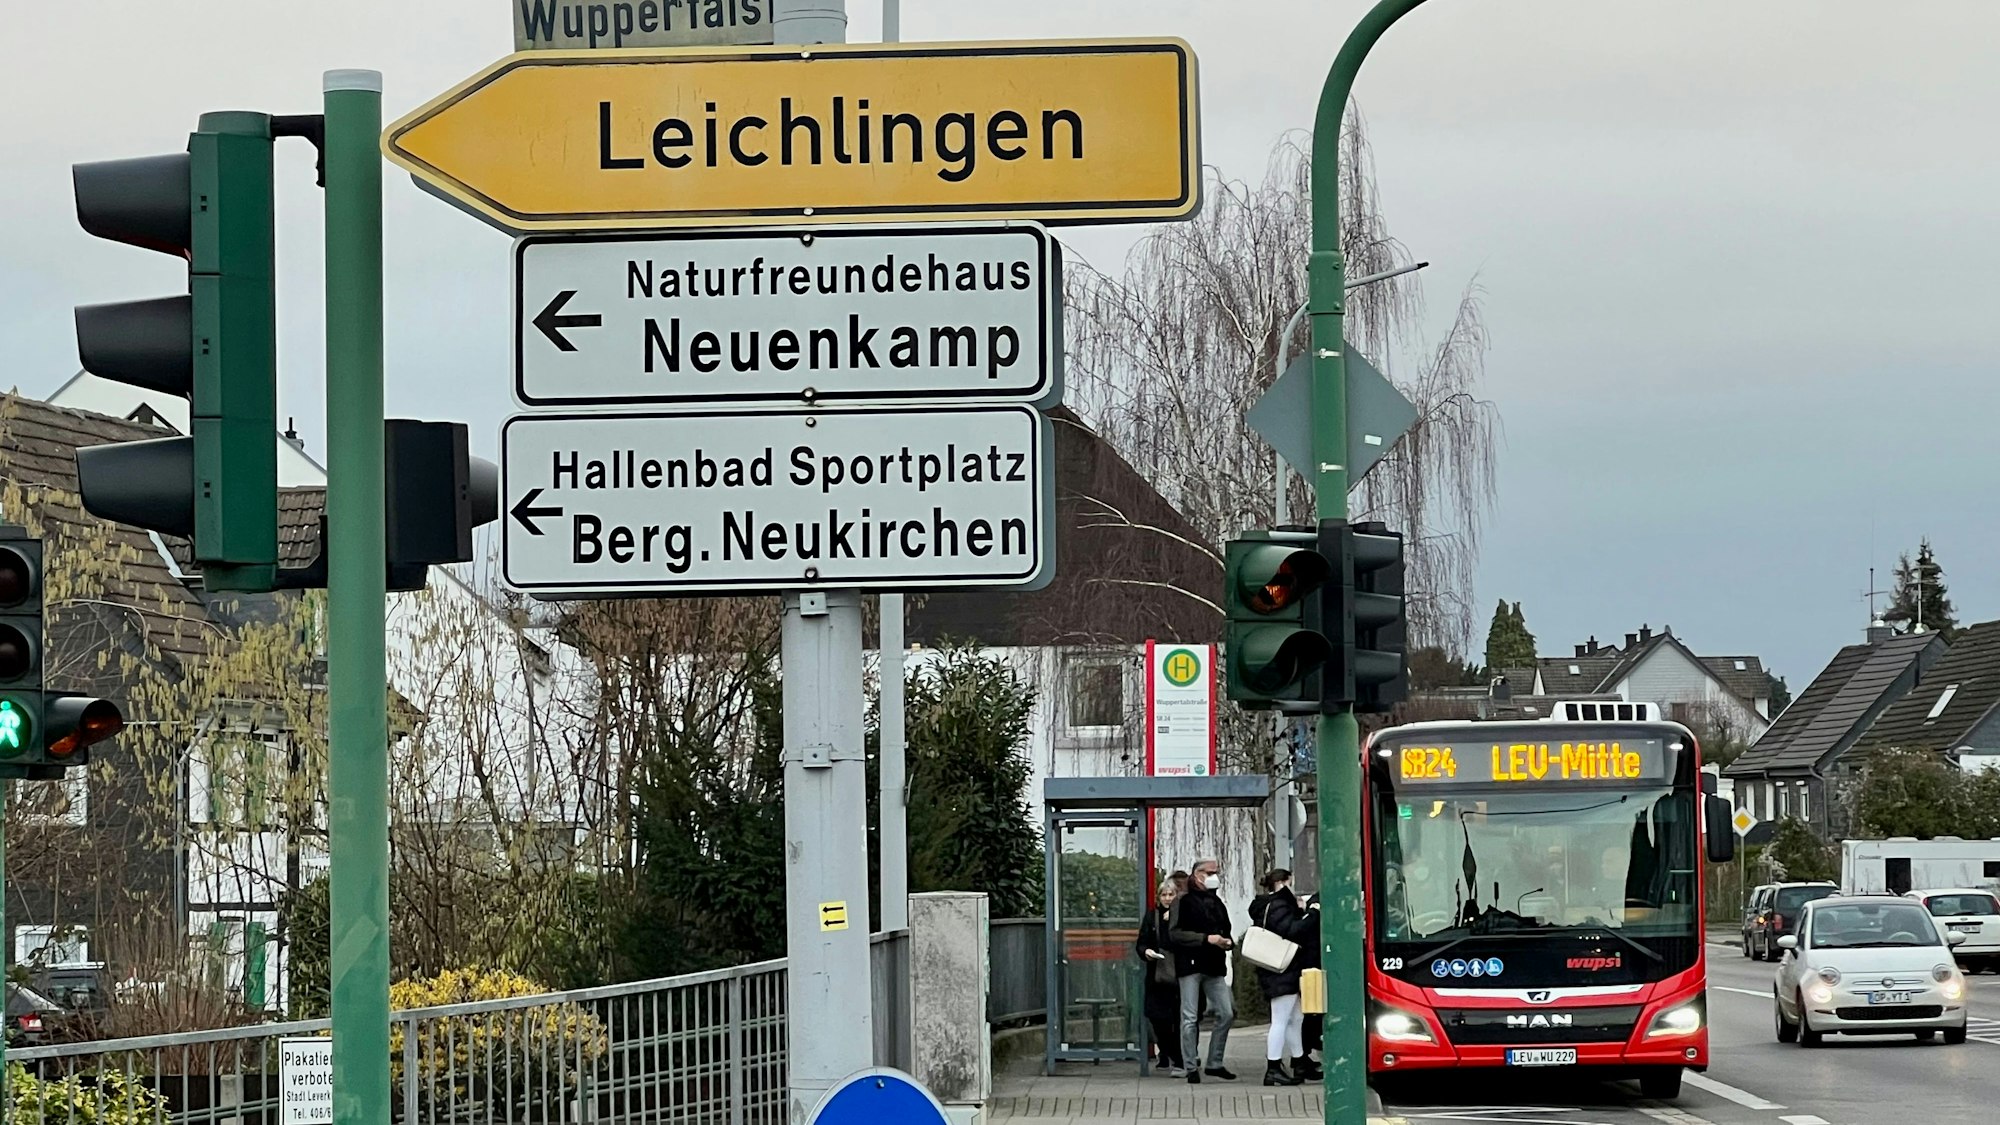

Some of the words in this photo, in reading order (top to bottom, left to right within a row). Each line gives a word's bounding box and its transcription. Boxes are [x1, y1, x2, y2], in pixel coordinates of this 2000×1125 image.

[600, 96, 1083, 182] Leichlingen
[627, 253, 1031, 298] Naturfreundehaus
[644, 314, 1020, 379] Neuenkamp
[553, 447, 773, 490] Hallenbad
[789, 444, 1026, 493] Sportplatz
[1174, 656, 1189, 678] H
[1158, 764, 1191, 775] wupsi
[1491, 743, 1641, 781] LEV-Mitte
[1382, 957, 1403, 970] 229
[1567, 952, 1621, 971] wupsi
[1507, 1014, 1573, 1028] MAN
[1513, 1051, 1533, 1063] LEV
[1540, 1051, 1553, 1062] WU
[1556, 1051, 1574, 1062] 229
[293, 1108, 307, 1119] Tel.
